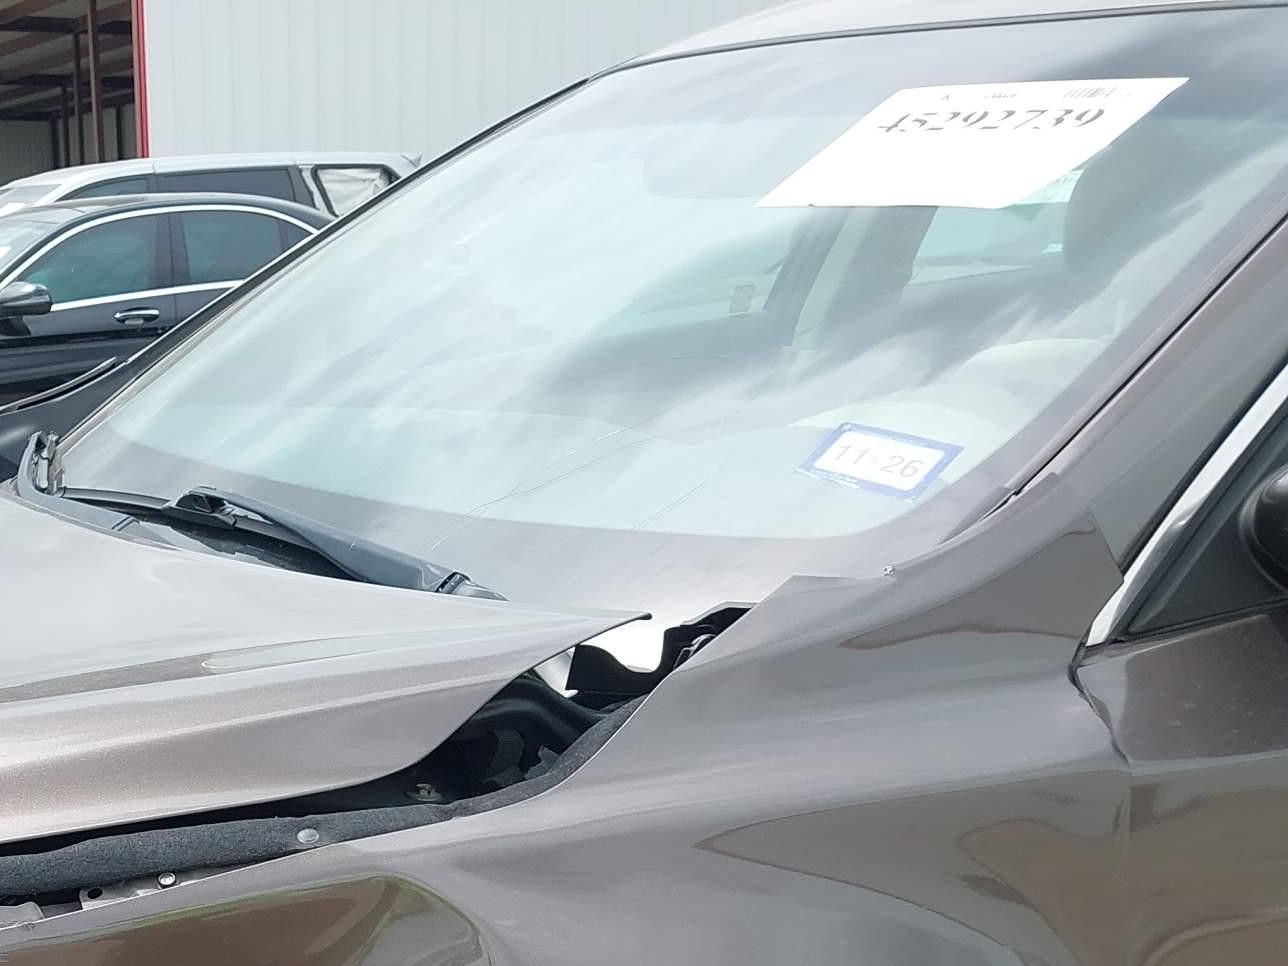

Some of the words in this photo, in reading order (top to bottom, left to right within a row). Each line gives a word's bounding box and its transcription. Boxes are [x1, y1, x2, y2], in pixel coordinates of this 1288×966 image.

[877, 108, 1105, 132] 45292739
[834, 444, 871, 465] 11
[879, 455, 925, 478] 26
